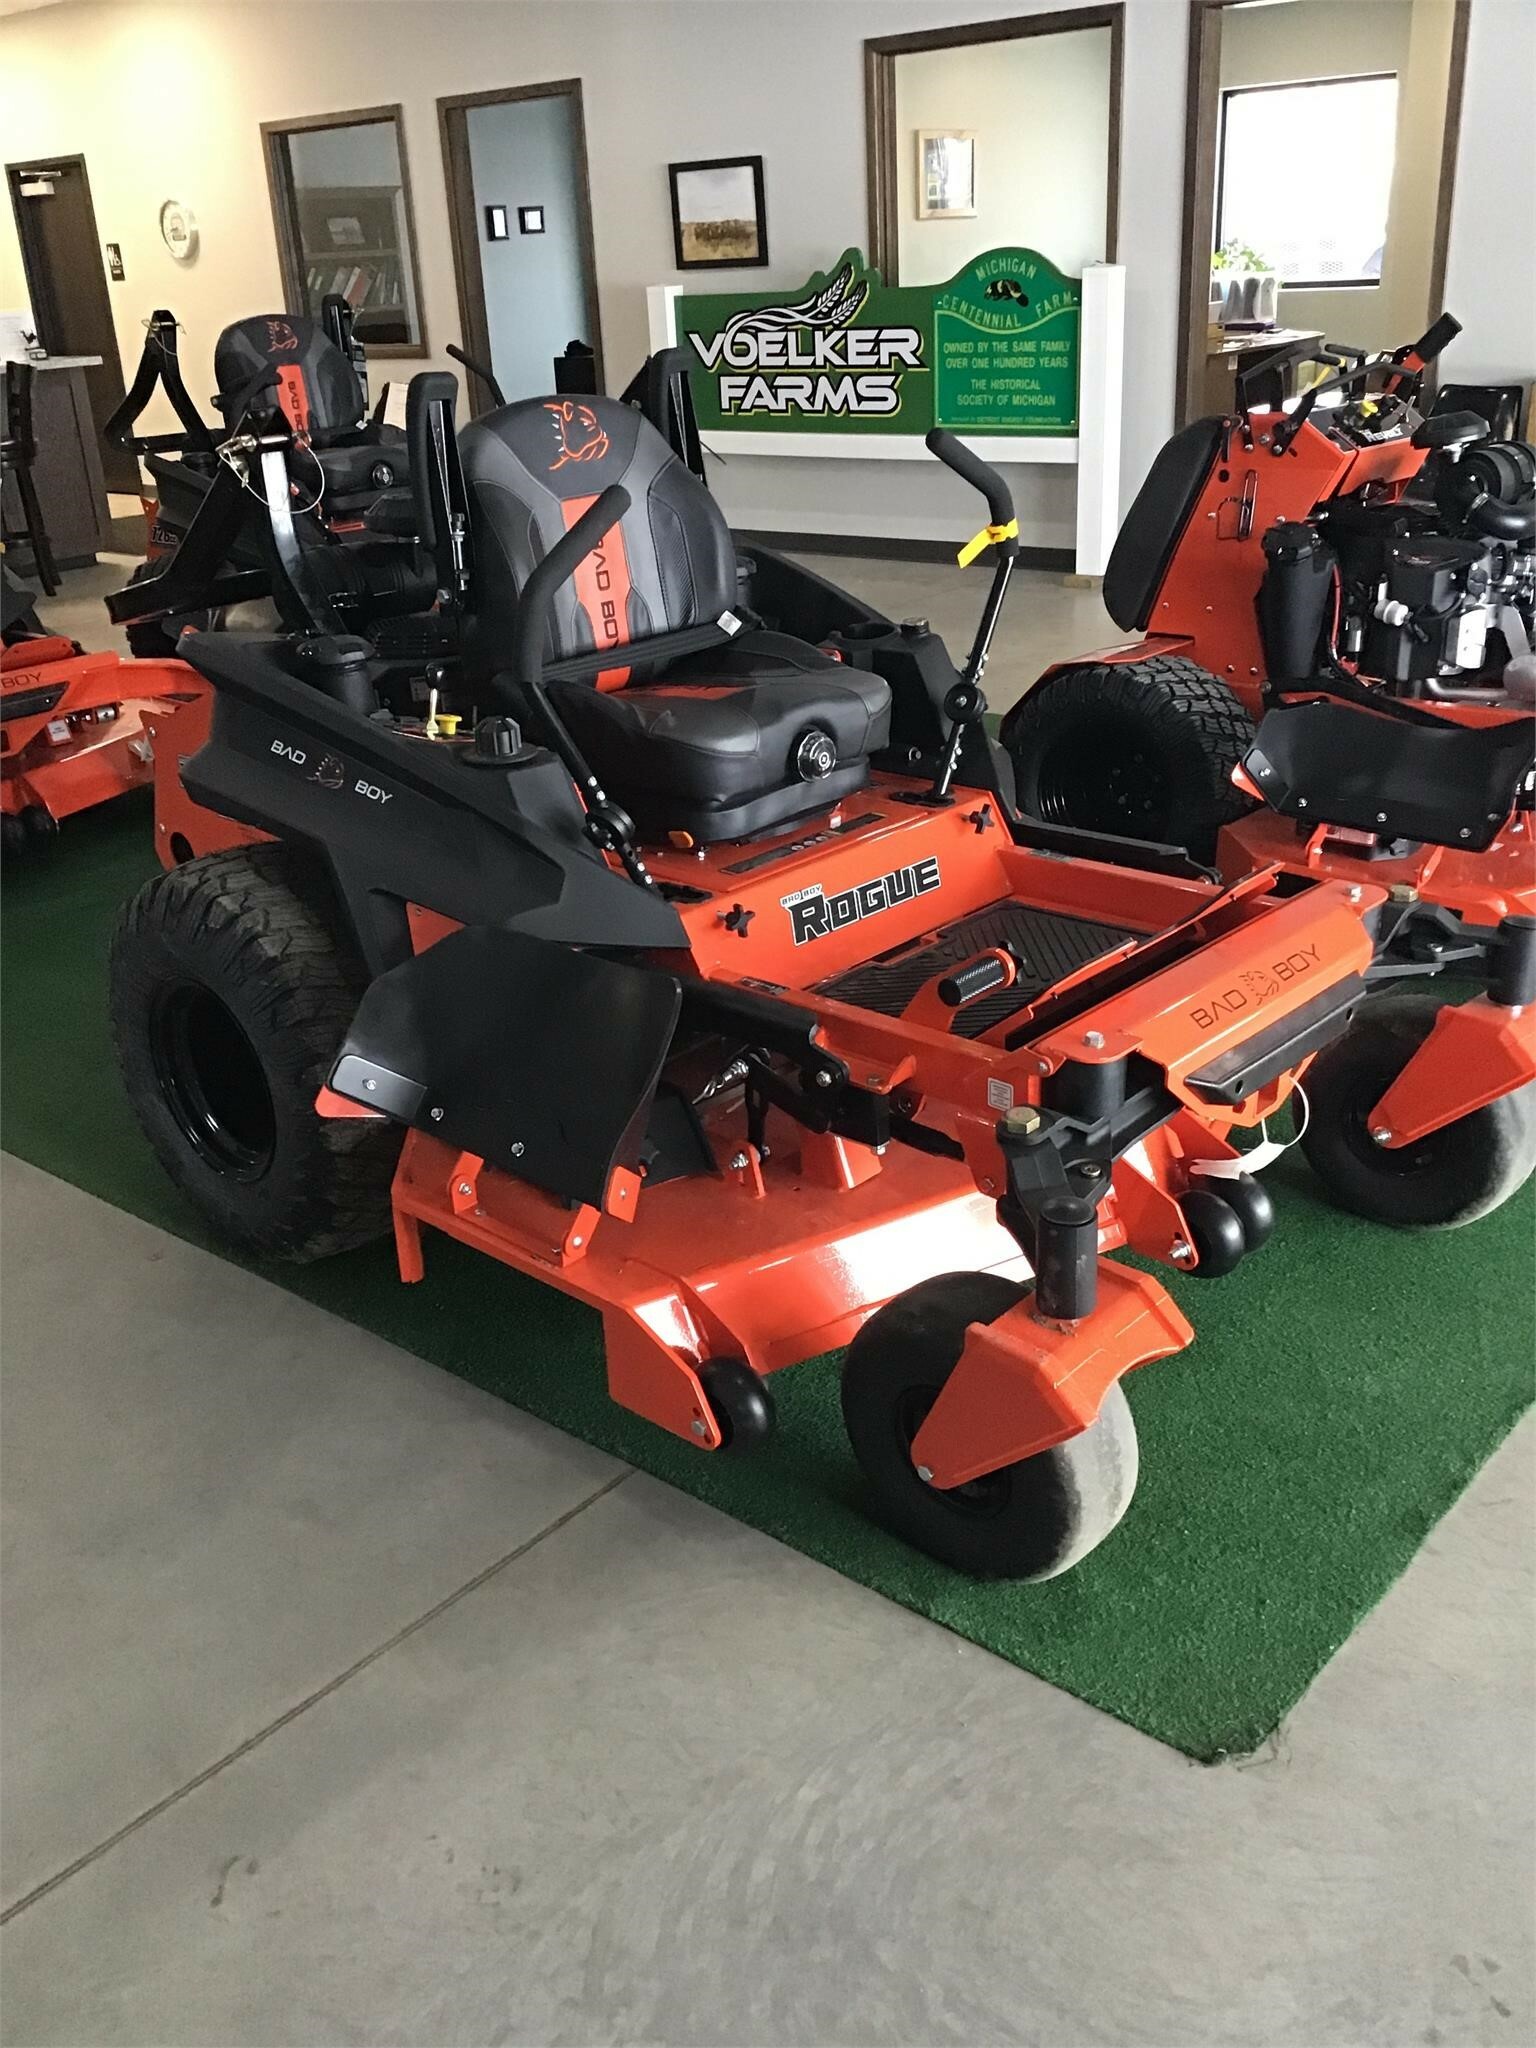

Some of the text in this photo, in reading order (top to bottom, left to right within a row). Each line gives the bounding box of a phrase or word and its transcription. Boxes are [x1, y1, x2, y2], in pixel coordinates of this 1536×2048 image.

[975, 258, 1037, 281] MICHIGAN
[942, 291, 1073, 328] CENTENNIAL FARM
[688, 328, 921, 366] VOELKER
[943, 341, 1072, 353] OWNED BY THE SAME FAMILY
[945, 357, 1069, 368] OVER ONE HUNDRED YEARS
[719, 375, 898, 412] FARMS
[970, 379, 1041, 390] THE HISTORICAL
[957, 394, 1056, 406] SOCIETY OF MICHIGAN
[1, 671, 42, 689] BOY
[270, 739, 393, 804] BAD BOY
[781, 884, 823, 906] BAD BOY
[787, 855, 942, 946] ROGUE
[1189, 943, 1321, 1029] BAD BOY
